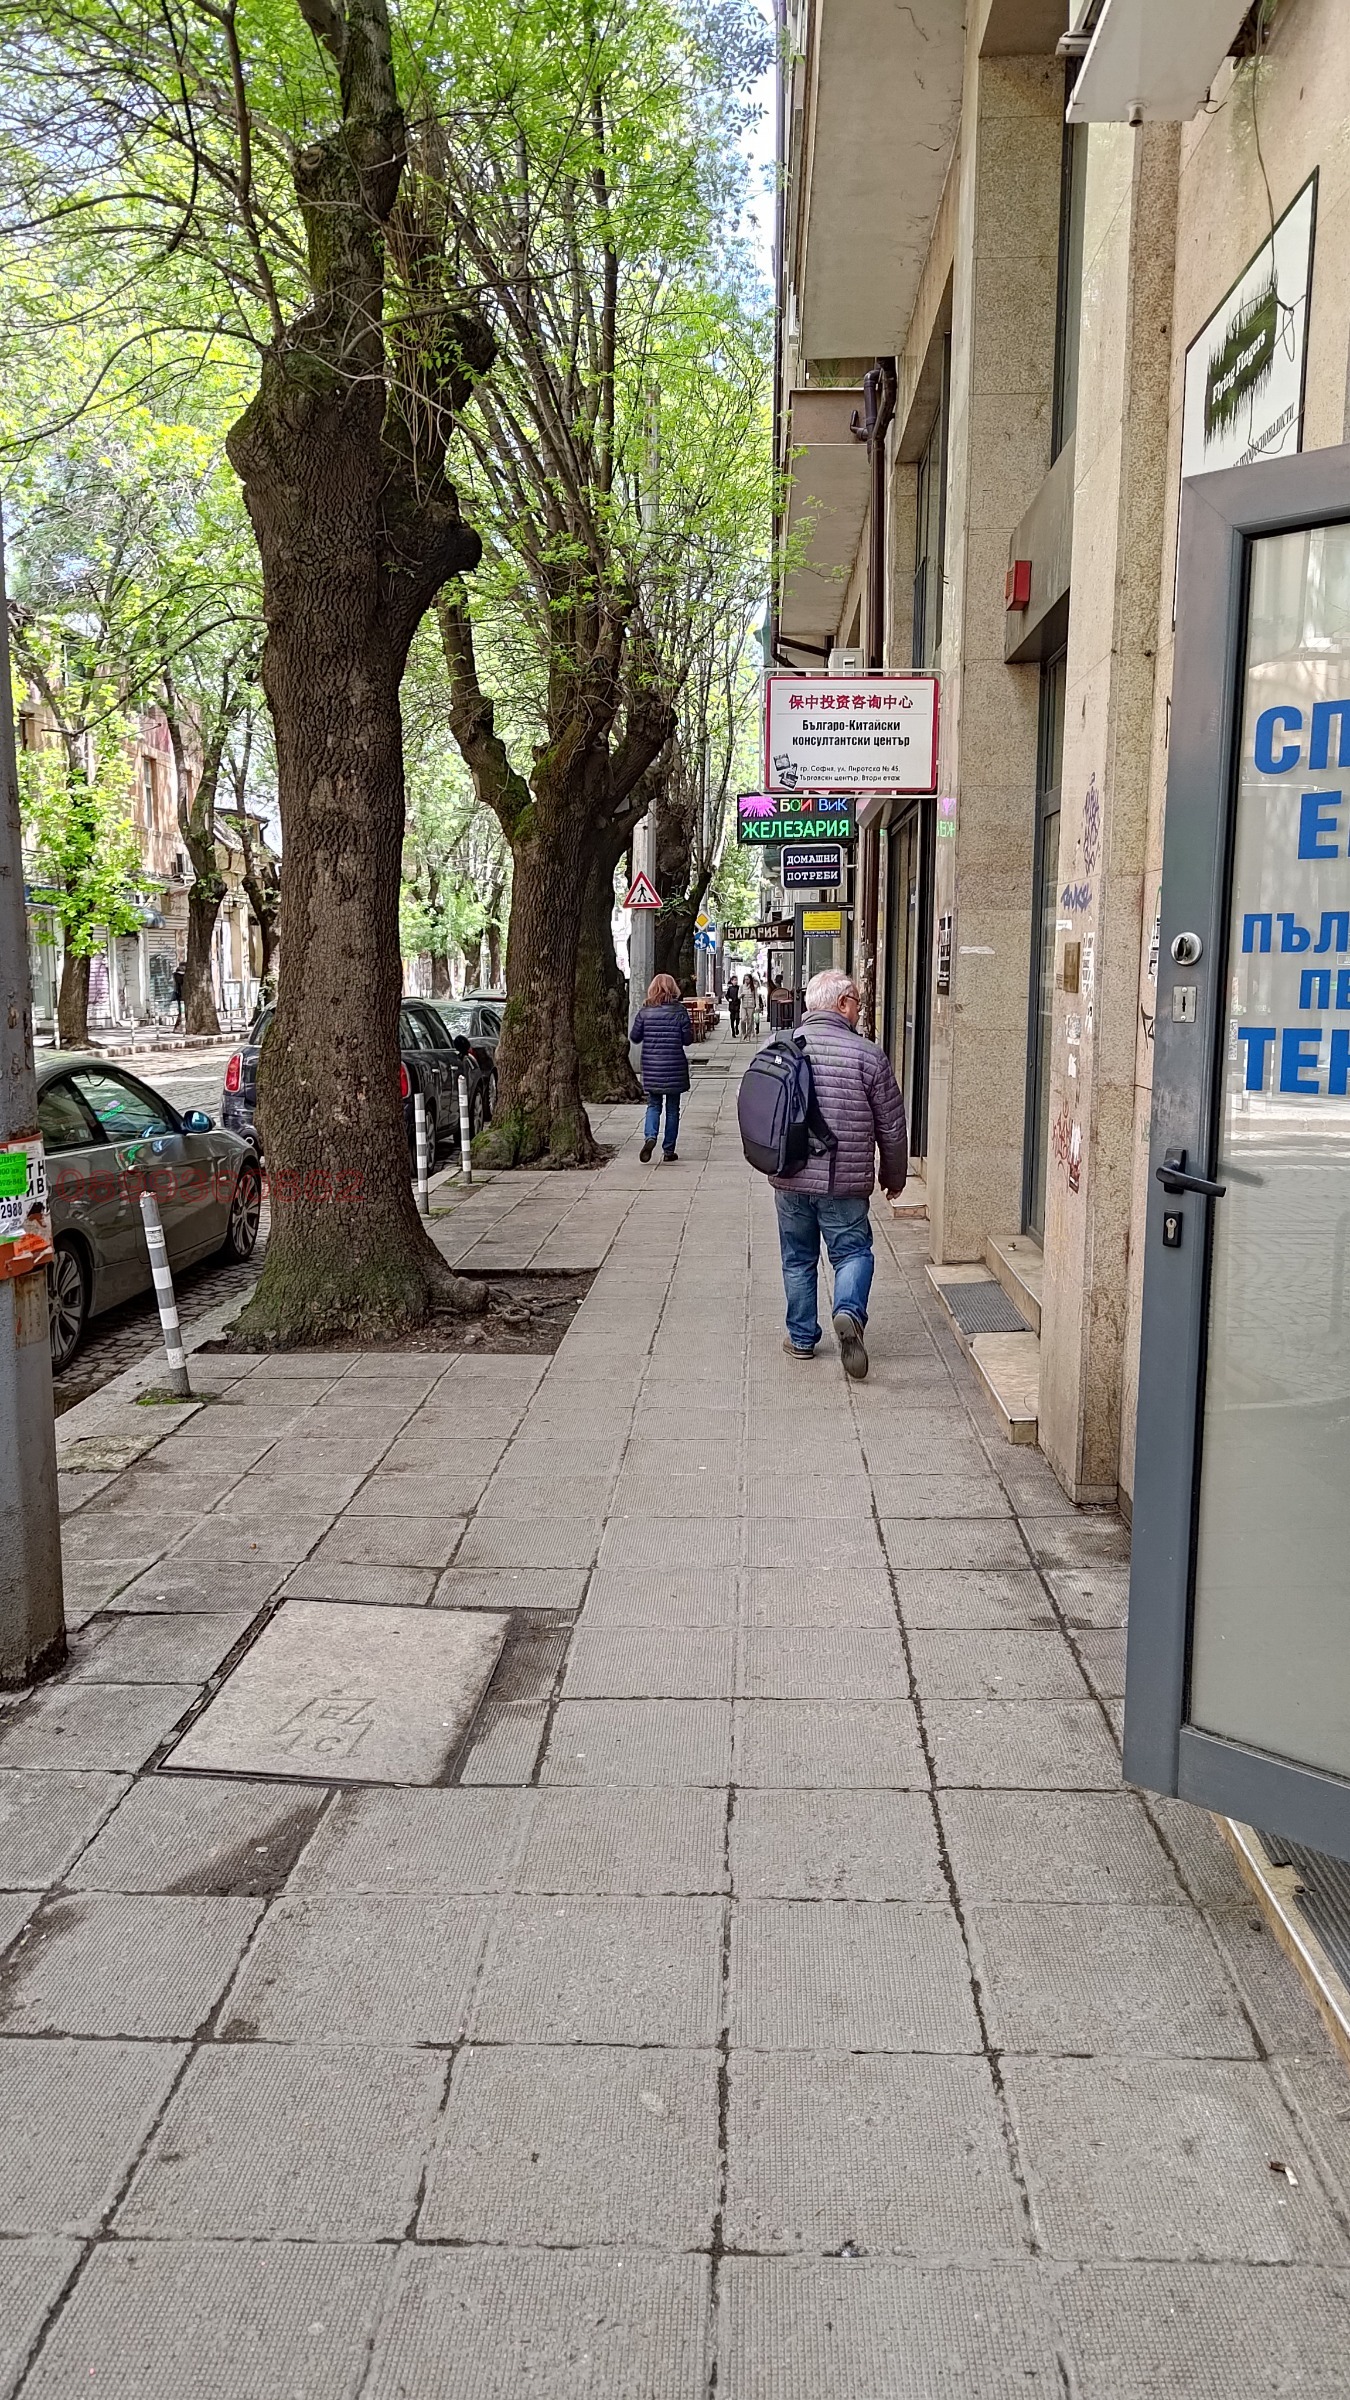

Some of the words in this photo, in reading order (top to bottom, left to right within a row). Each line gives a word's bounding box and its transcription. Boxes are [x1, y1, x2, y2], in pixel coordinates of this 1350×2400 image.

[1212, 366, 1236, 405] Flying
[1236, 329, 1266, 376] Fingers
[788, 694, 914, 710] 保中投资咨询中心
[802, 719, 901, 732] Българо-Китайски
[792, 736, 870, 747] консултантски
[873, 736, 910, 747] център
[848, 765, 881, 773] Пиротска
[861, 774, 882, 782] Втори
[742, 820, 849, 838] ЖЕЛЕЗАРИЯ
[786, 854, 838, 866] ДОМАШНИ
[787, 870, 838, 881] ПОТРЕБИ
[727, 925, 779, 939] БИРАРИЯ
[1241, 911, 1350, 954] ПЪЛ
